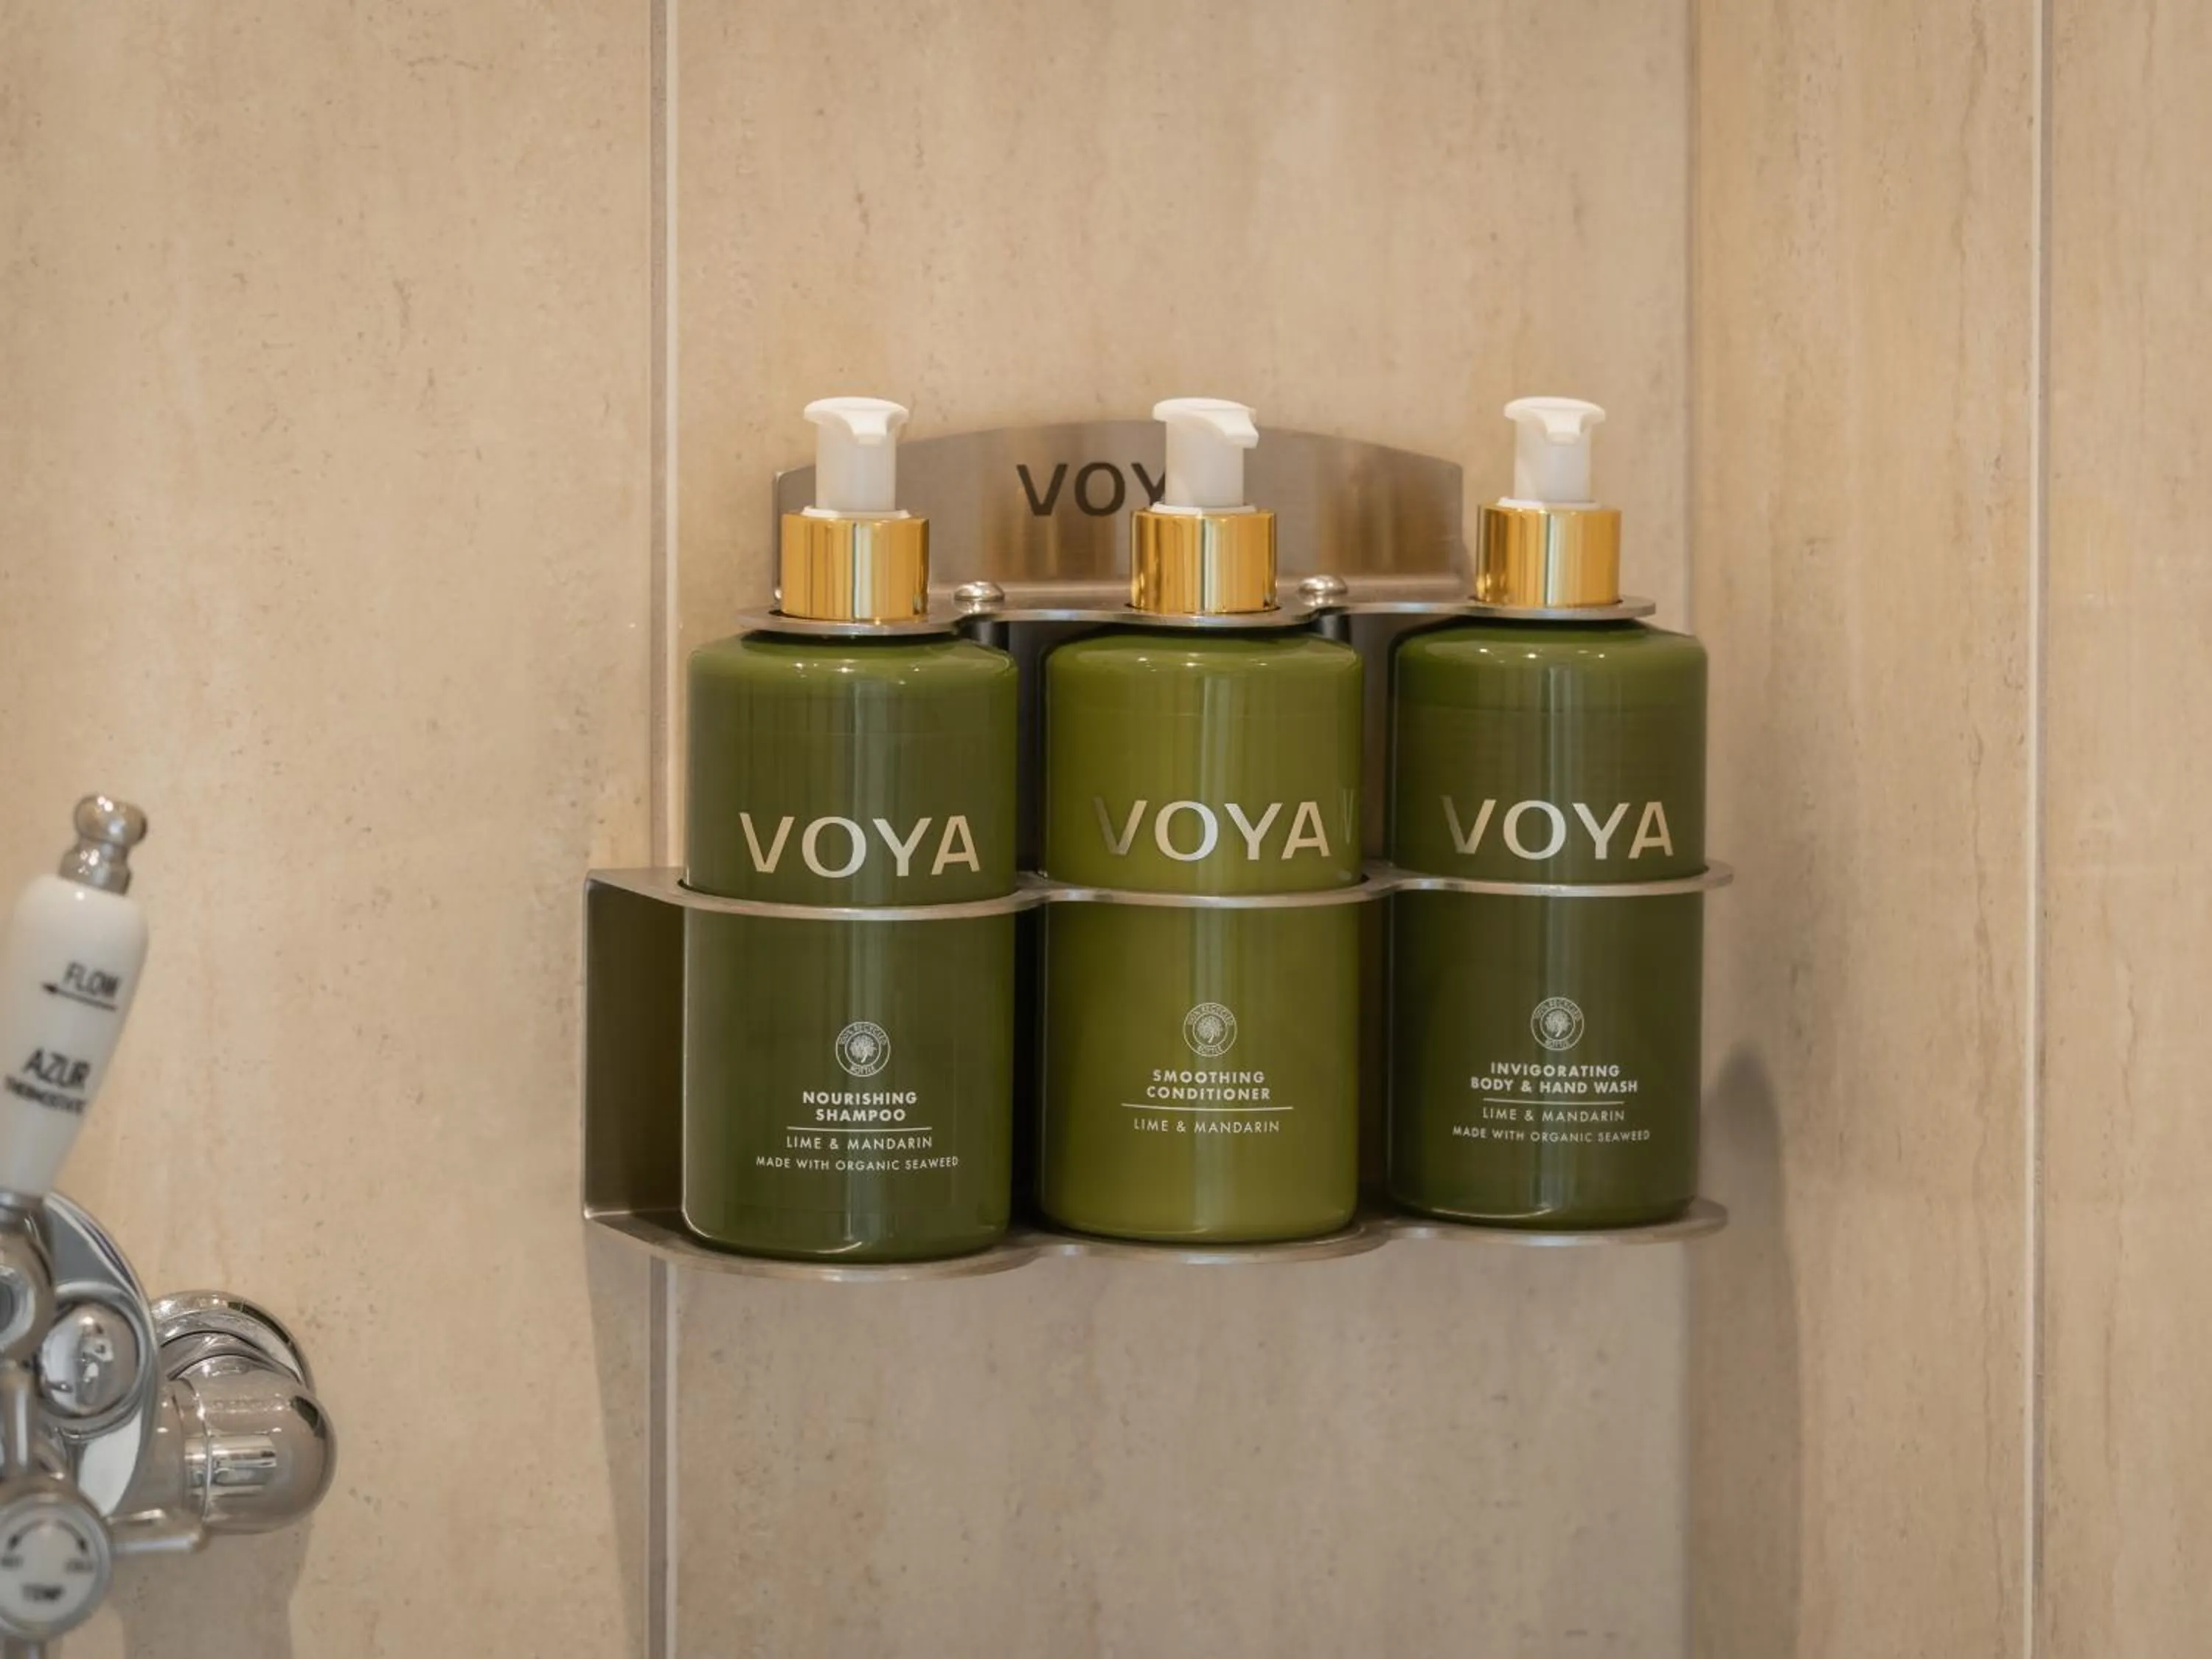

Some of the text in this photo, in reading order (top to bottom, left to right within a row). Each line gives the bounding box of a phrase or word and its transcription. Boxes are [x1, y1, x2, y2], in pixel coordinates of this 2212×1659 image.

[1016, 462, 1166, 517] VOY
[1093, 796, 1331, 861] VOYA
[1440, 795, 1674, 860] VOYA
[739, 813, 980, 878] VOYA
[63, 961, 122, 998] FLOW
[22, 1048, 91, 1093] AZUR
[1152, 1070, 1265, 1084] SMOOTHING
[1490, 1062, 1620, 1078] INVIGORATING
[1147, 1086, 1270, 1101] CONDITIONER
[1471, 1077, 1638, 1094] BODY & HAND WASH
[803, 1091, 917, 1105] NOURISHING
[815, 1109, 906, 1121] SHAMPOO
[1483, 1107, 1625, 1122] LIME & MANDARIN
[1134, 1118, 1280, 1133] LIME & MANDARIN
[1453, 1125, 1650, 1142] MADE WITH ORGANIC SEAWEED
[787, 1135, 932, 1150] LIME & MANDARIN
[757, 1156, 959, 1171] MADE WITH ORGANIC SEAWEED
